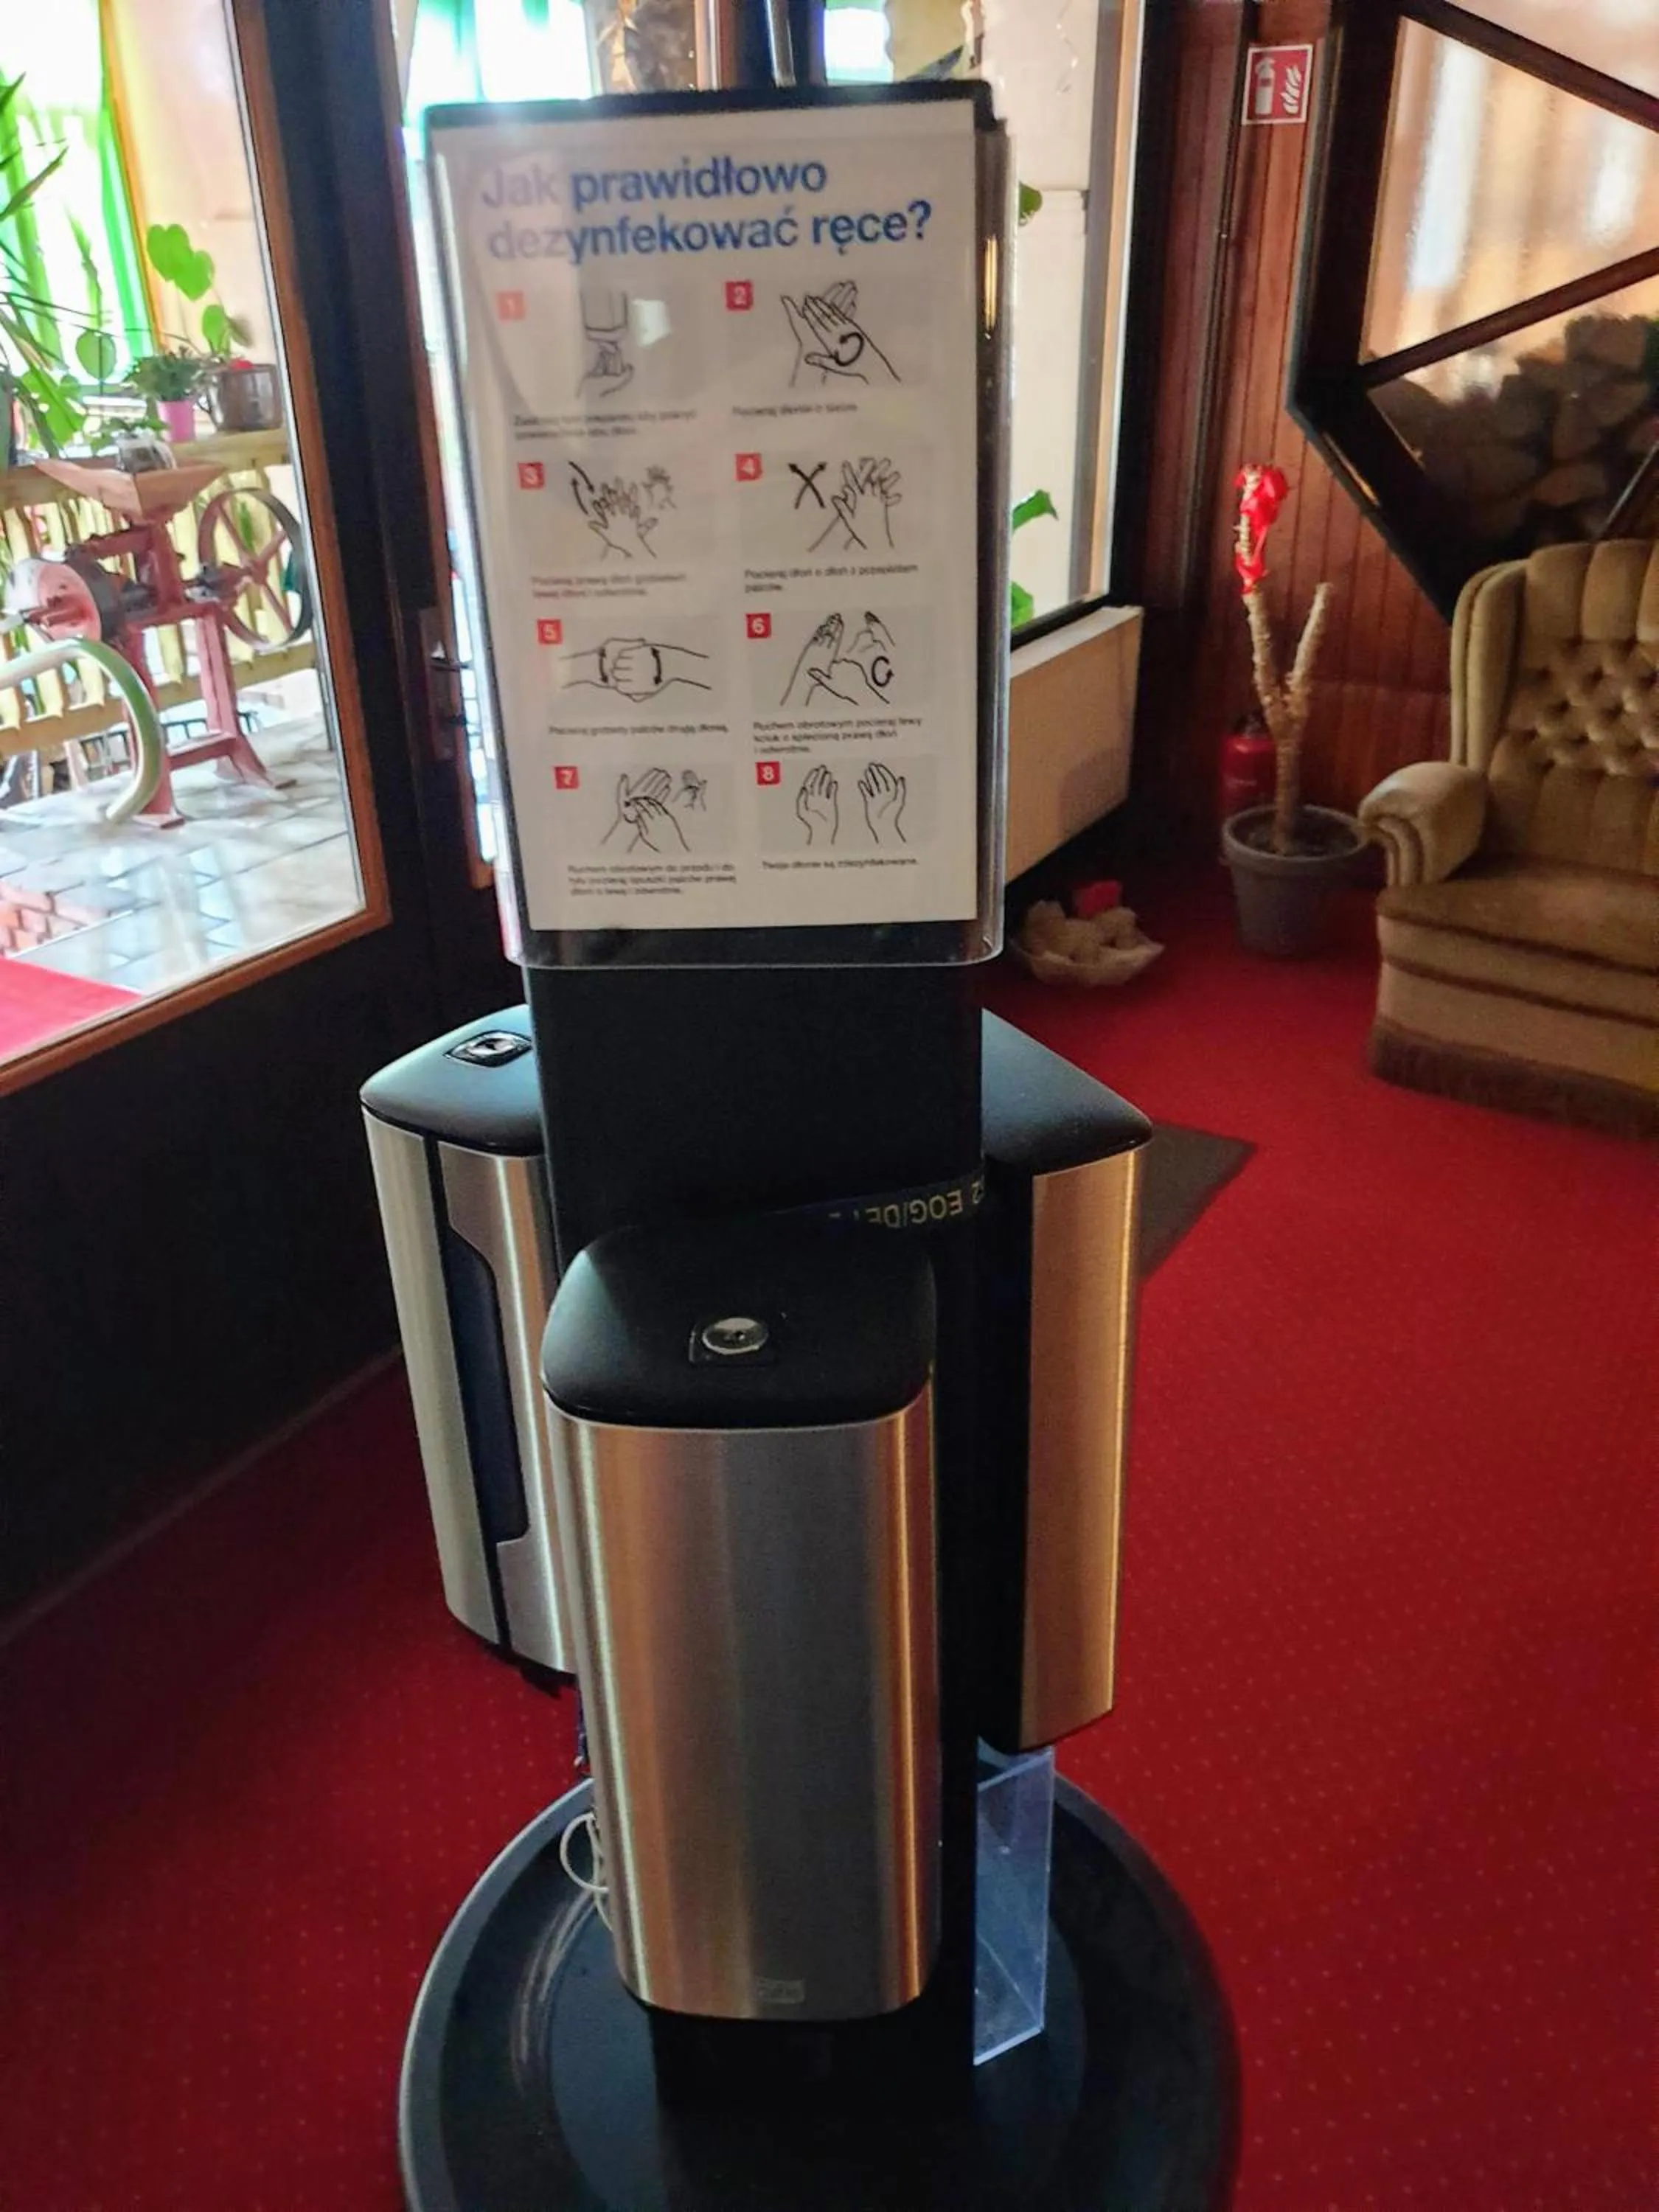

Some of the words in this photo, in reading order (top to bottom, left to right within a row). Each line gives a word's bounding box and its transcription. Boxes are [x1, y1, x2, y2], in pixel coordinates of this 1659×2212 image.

[481, 164, 559, 209] Jak
[570, 155, 827, 214] prawidłowo
[487, 204, 799, 265] dezynfekować
[811, 198, 932, 257] ręce?
[734, 285, 746, 305] 2
[740, 457, 756, 478] 4
[543, 624, 557, 641] 5
[752, 617, 765, 635] 6
[560, 770, 573, 786] 7
[762, 765, 774, 782] 8
